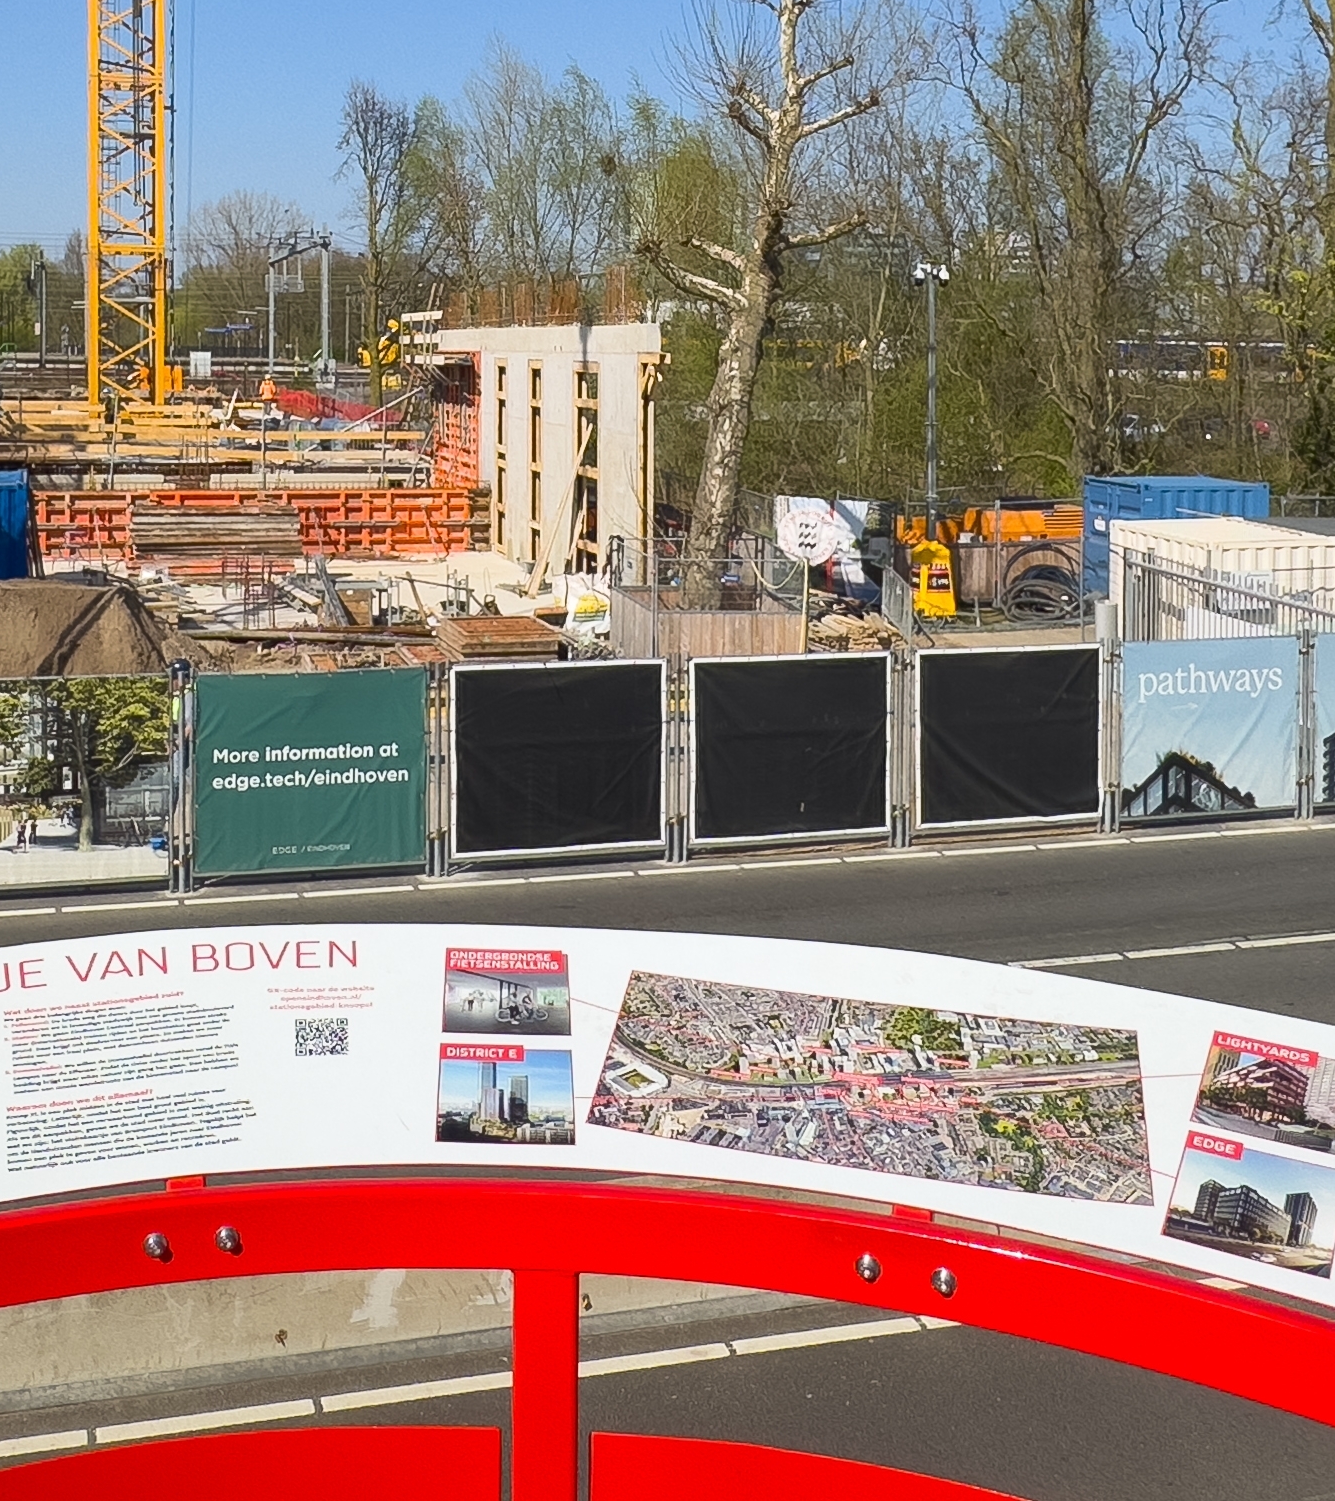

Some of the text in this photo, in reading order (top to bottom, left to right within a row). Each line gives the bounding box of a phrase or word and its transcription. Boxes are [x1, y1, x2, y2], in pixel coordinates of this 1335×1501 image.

[1138, 663, 1283, 703] pathways
[213, 742, 399, 764] More information at
[212, 767, 409, 792] edge.tech/eindhoven
[272, 845, 297, 855] EDGE
[65, 947, 168, 982] VAN
[191, 940, 358, 973] BOVEN
[450, 950, 551, 962] ONDERGRONDSE
[450, 959, 559, 970] FIETSENSTALLING
[446, 1047, 517, 1058] DISTRICT E
[1217, 1034, 1310, 1063] LIGHTYARDS
[1192, 1136, 1236, 1155] EDGE
